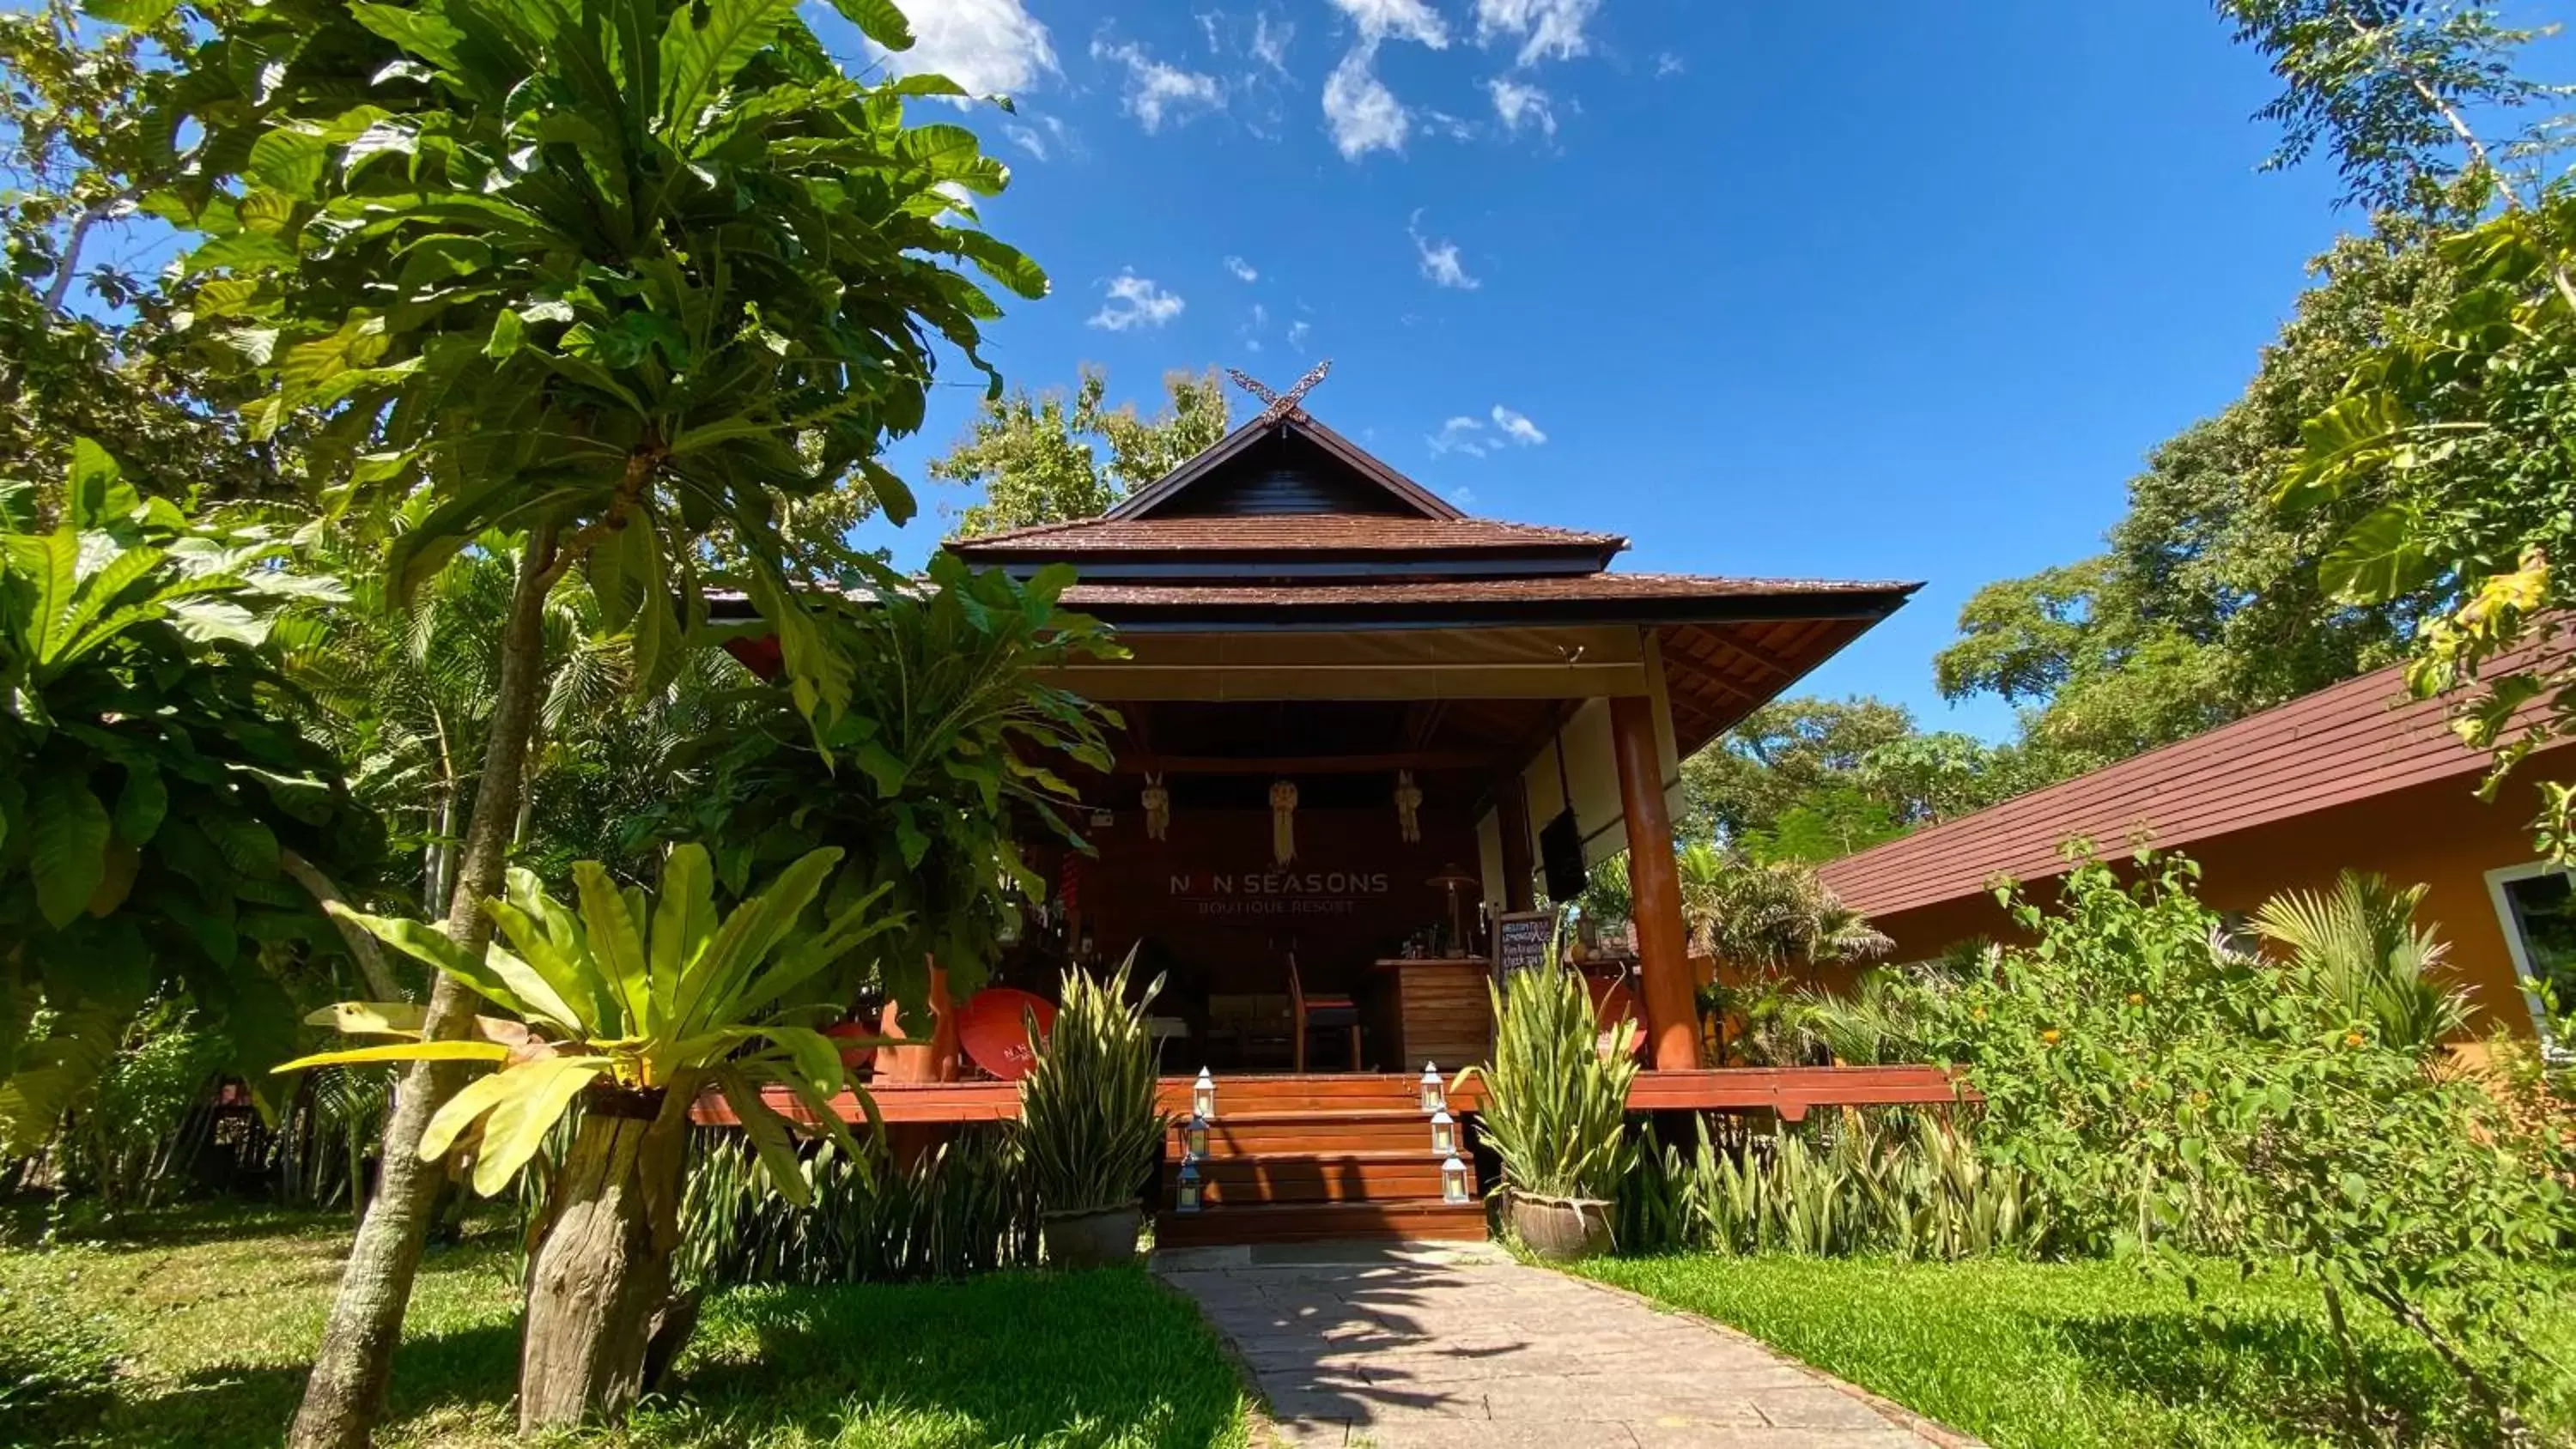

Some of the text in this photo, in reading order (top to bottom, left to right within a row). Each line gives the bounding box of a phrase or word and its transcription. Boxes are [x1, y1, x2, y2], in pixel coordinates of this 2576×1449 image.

[1169, 872, 1389, 894] NN SEASONS
[1198, 900, 1354, 914] BOUTIQUE RESORT
